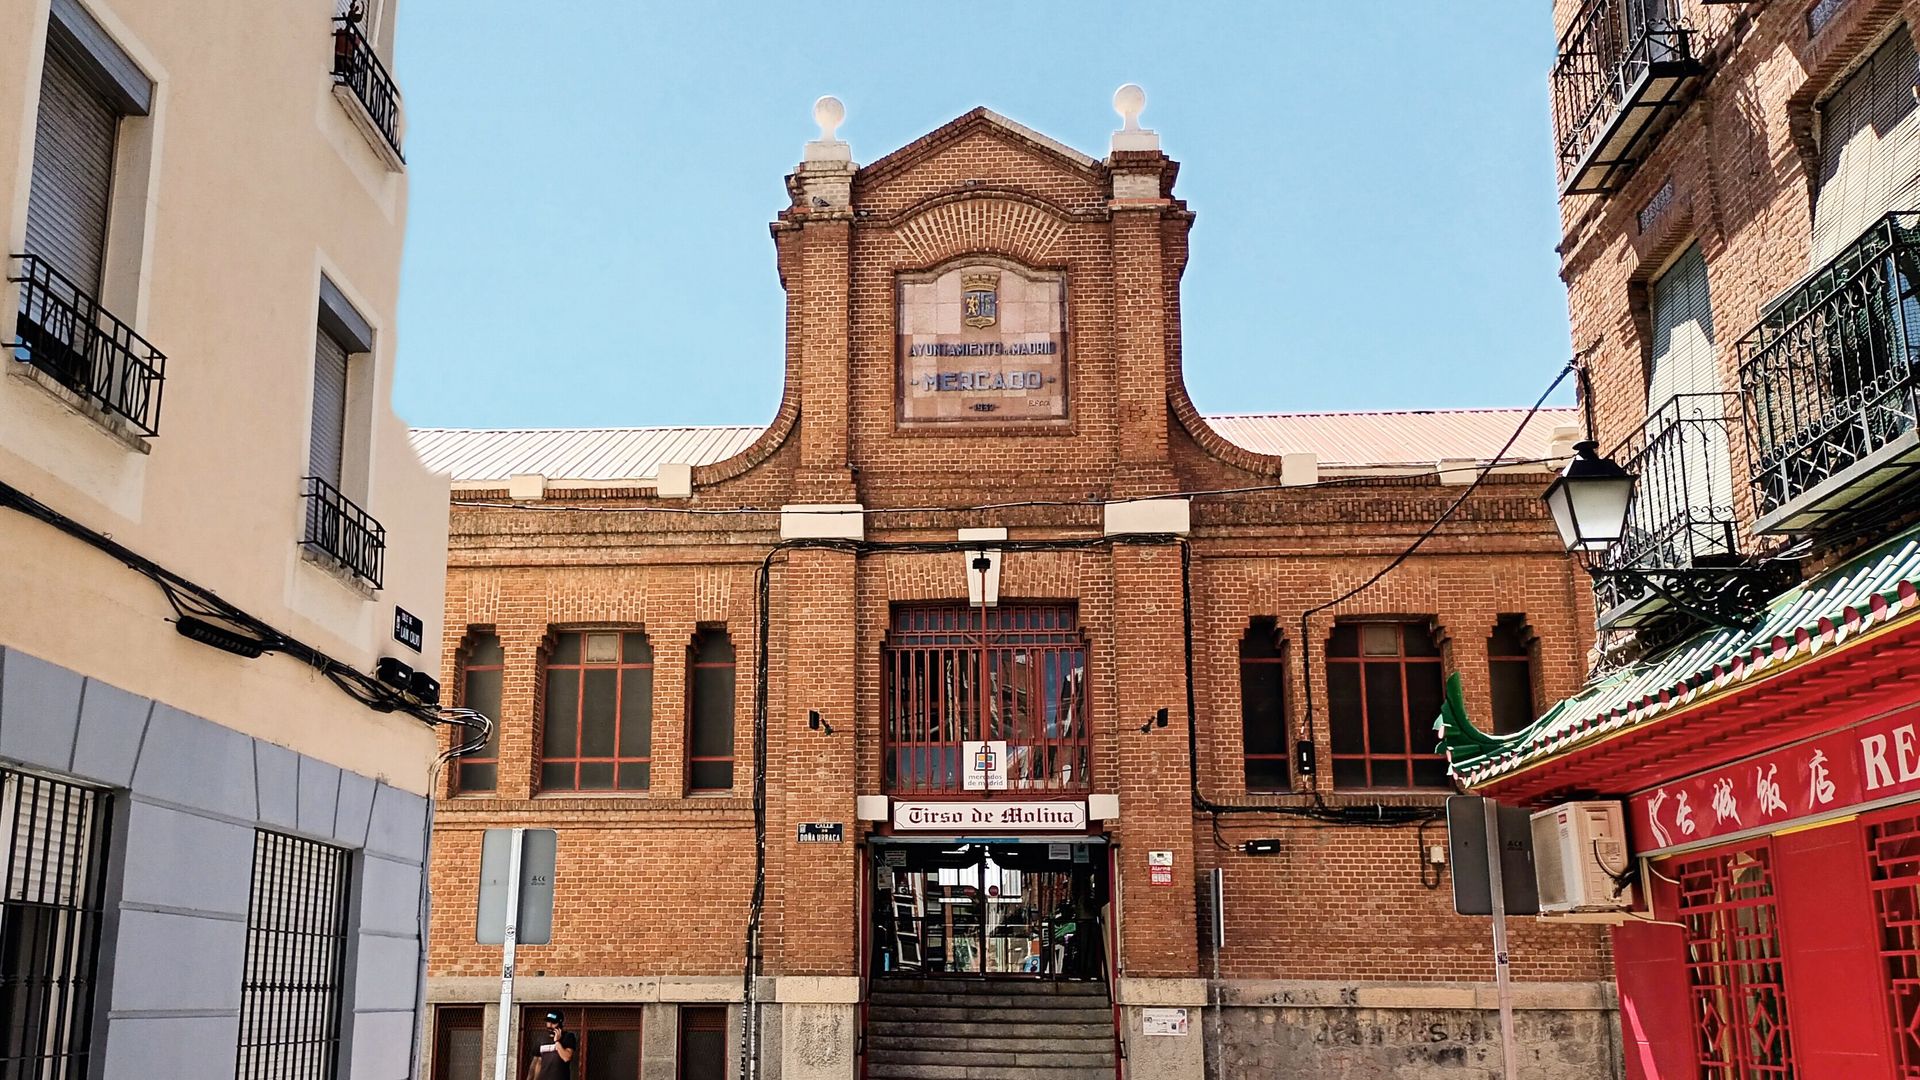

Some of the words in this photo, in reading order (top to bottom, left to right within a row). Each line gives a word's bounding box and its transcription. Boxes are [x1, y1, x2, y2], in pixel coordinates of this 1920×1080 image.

[909, 342, 1003, 357] AYUNTAMIENTO
[1012, 341, 1056, 355] MADRID
[924, 370, 1041, 391] MERCADO
[908, 807, 963, 824] Tirso
[971, 807, 994, 824] de
[1000, 807, 1074, 824] Molina
[800, 832, 815, 842] DOÑA
[816, 833, 840, 842] URRACA
